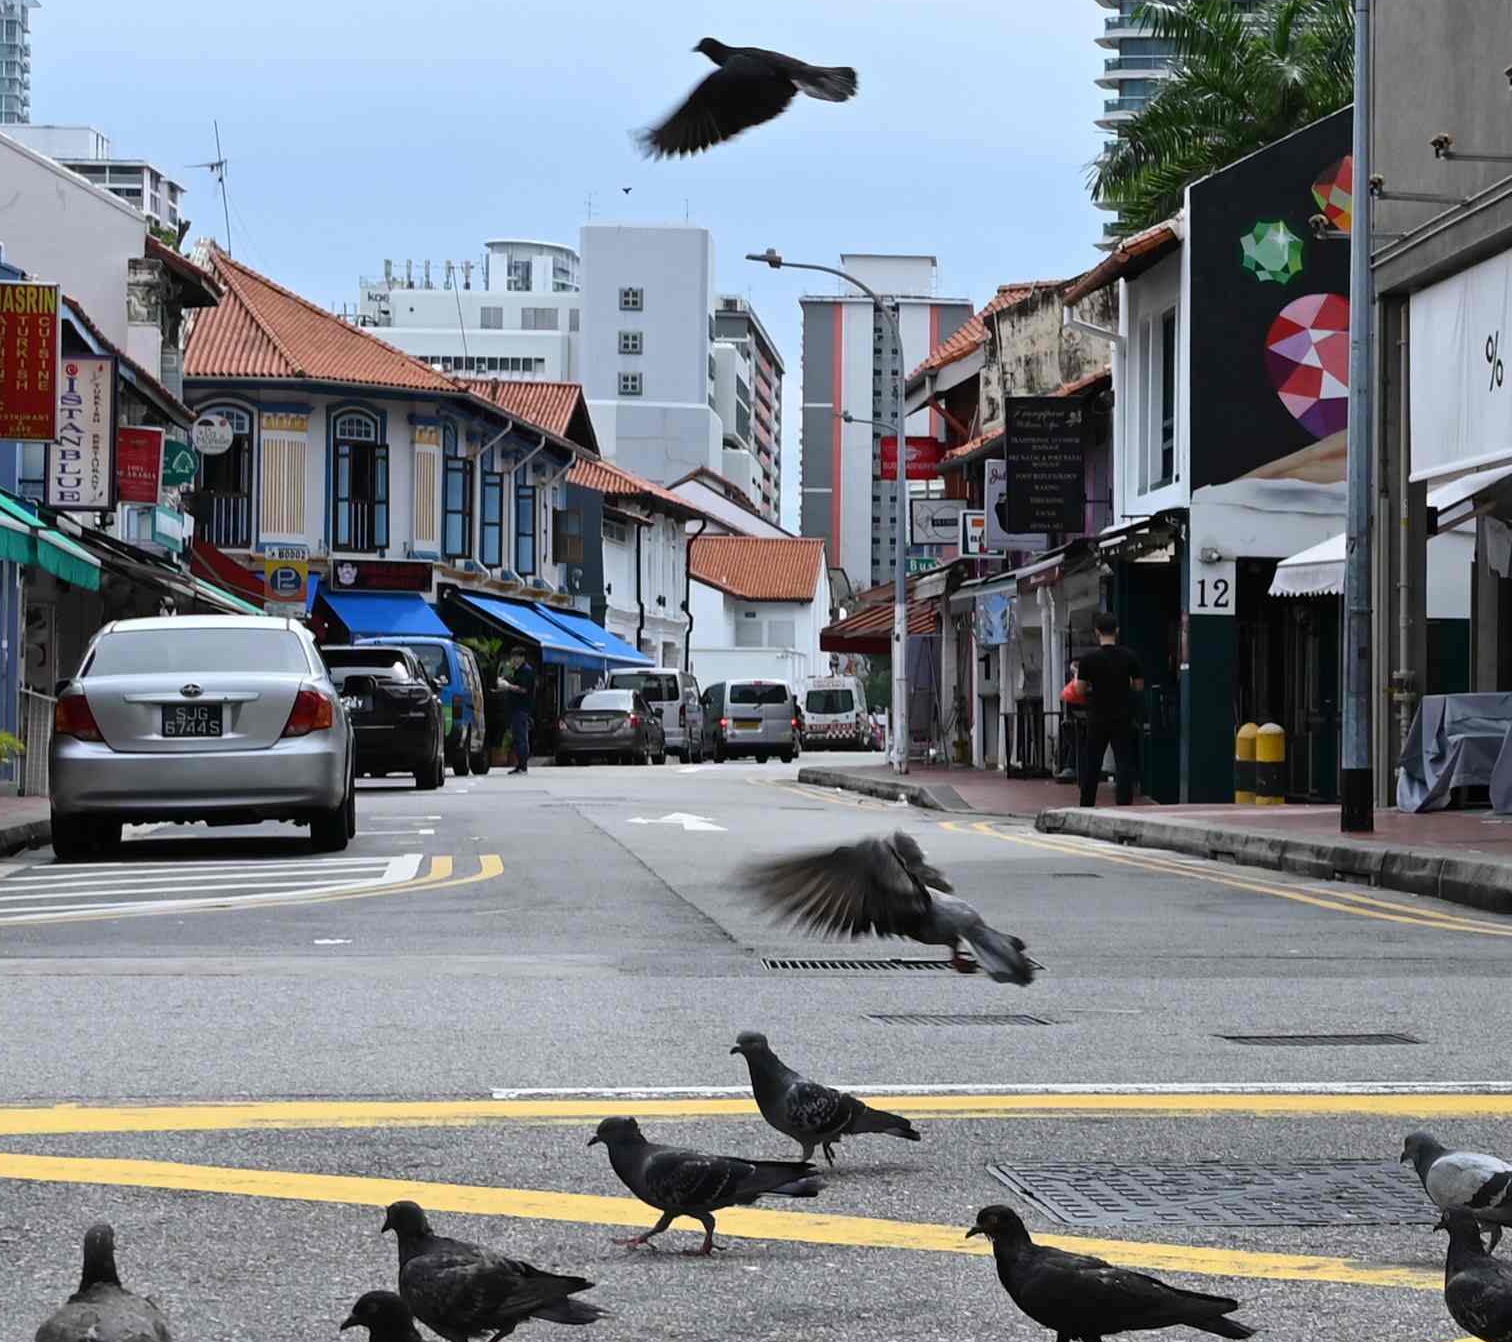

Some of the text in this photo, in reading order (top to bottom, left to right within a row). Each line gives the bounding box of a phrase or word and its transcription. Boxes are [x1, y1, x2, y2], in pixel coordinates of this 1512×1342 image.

[16, 316, 29, 391] TURKISH
[38, 316, 50, 391] CUISINE
[57, 377, 83, 503] ISTANBLUE
[1196, 579, 1230, 609] 12
[165, 720, 220, 735] 6744S
[175, 706, 208, 720] SJG
